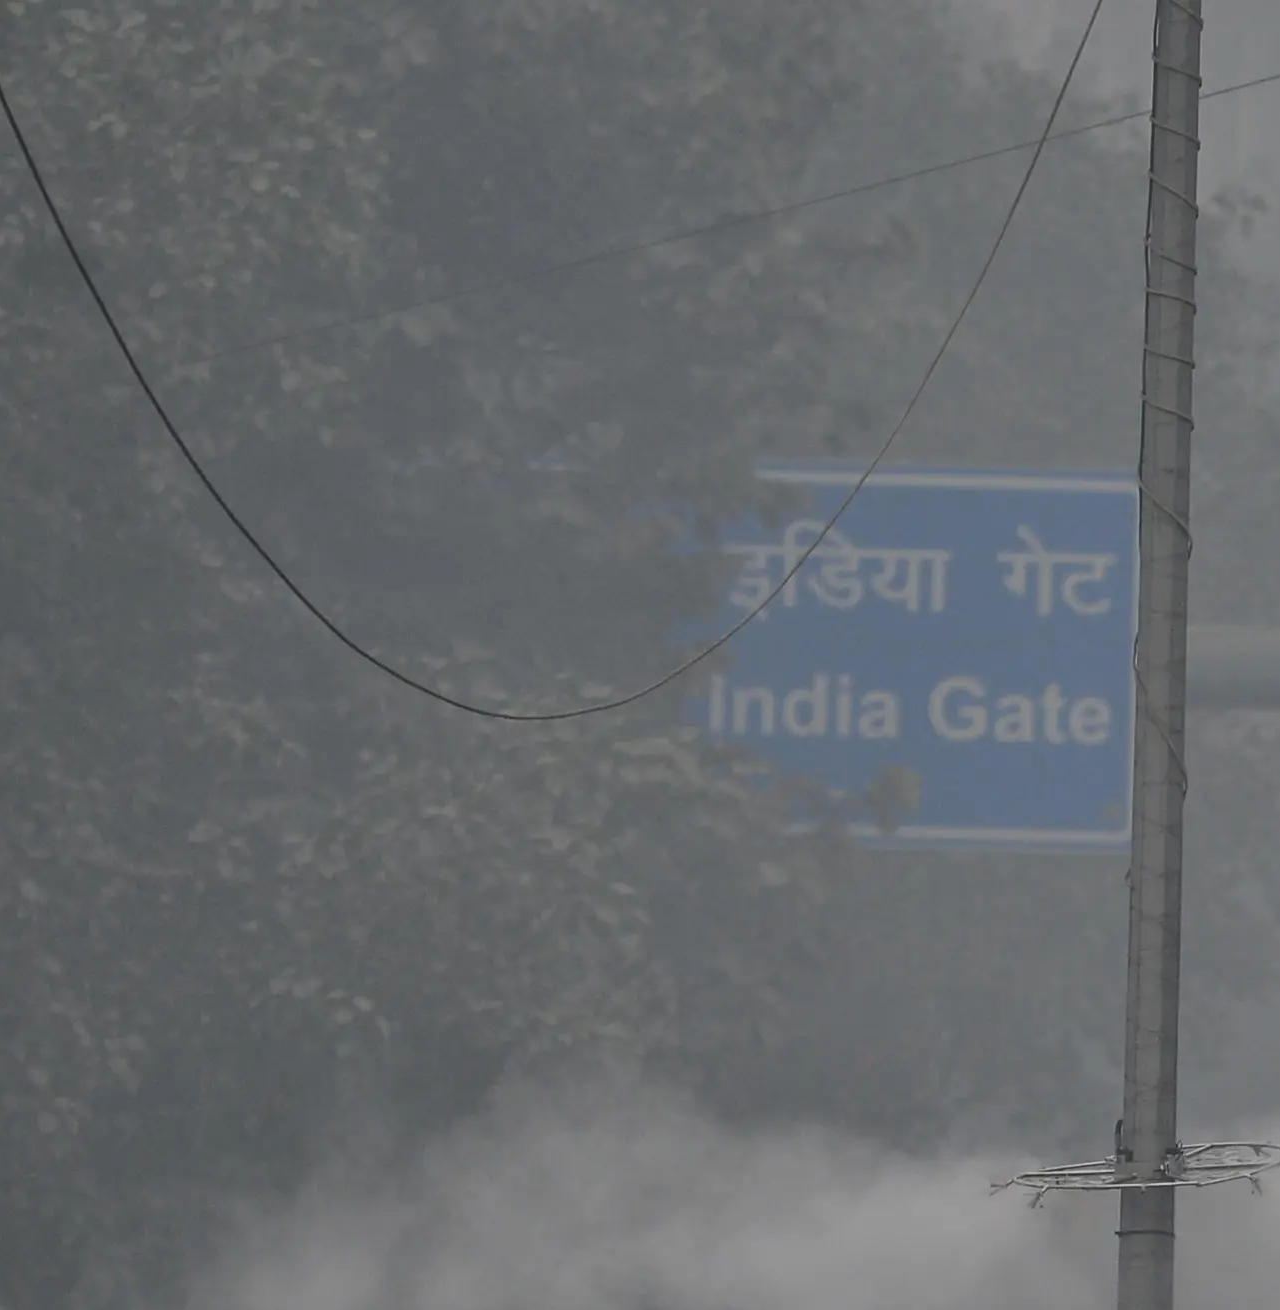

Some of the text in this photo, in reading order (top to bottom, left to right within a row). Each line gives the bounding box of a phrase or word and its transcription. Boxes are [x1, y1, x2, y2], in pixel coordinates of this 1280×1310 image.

[996, 524, 1119, 617] गेट
[709, 673, 1112, 746] India Gate
